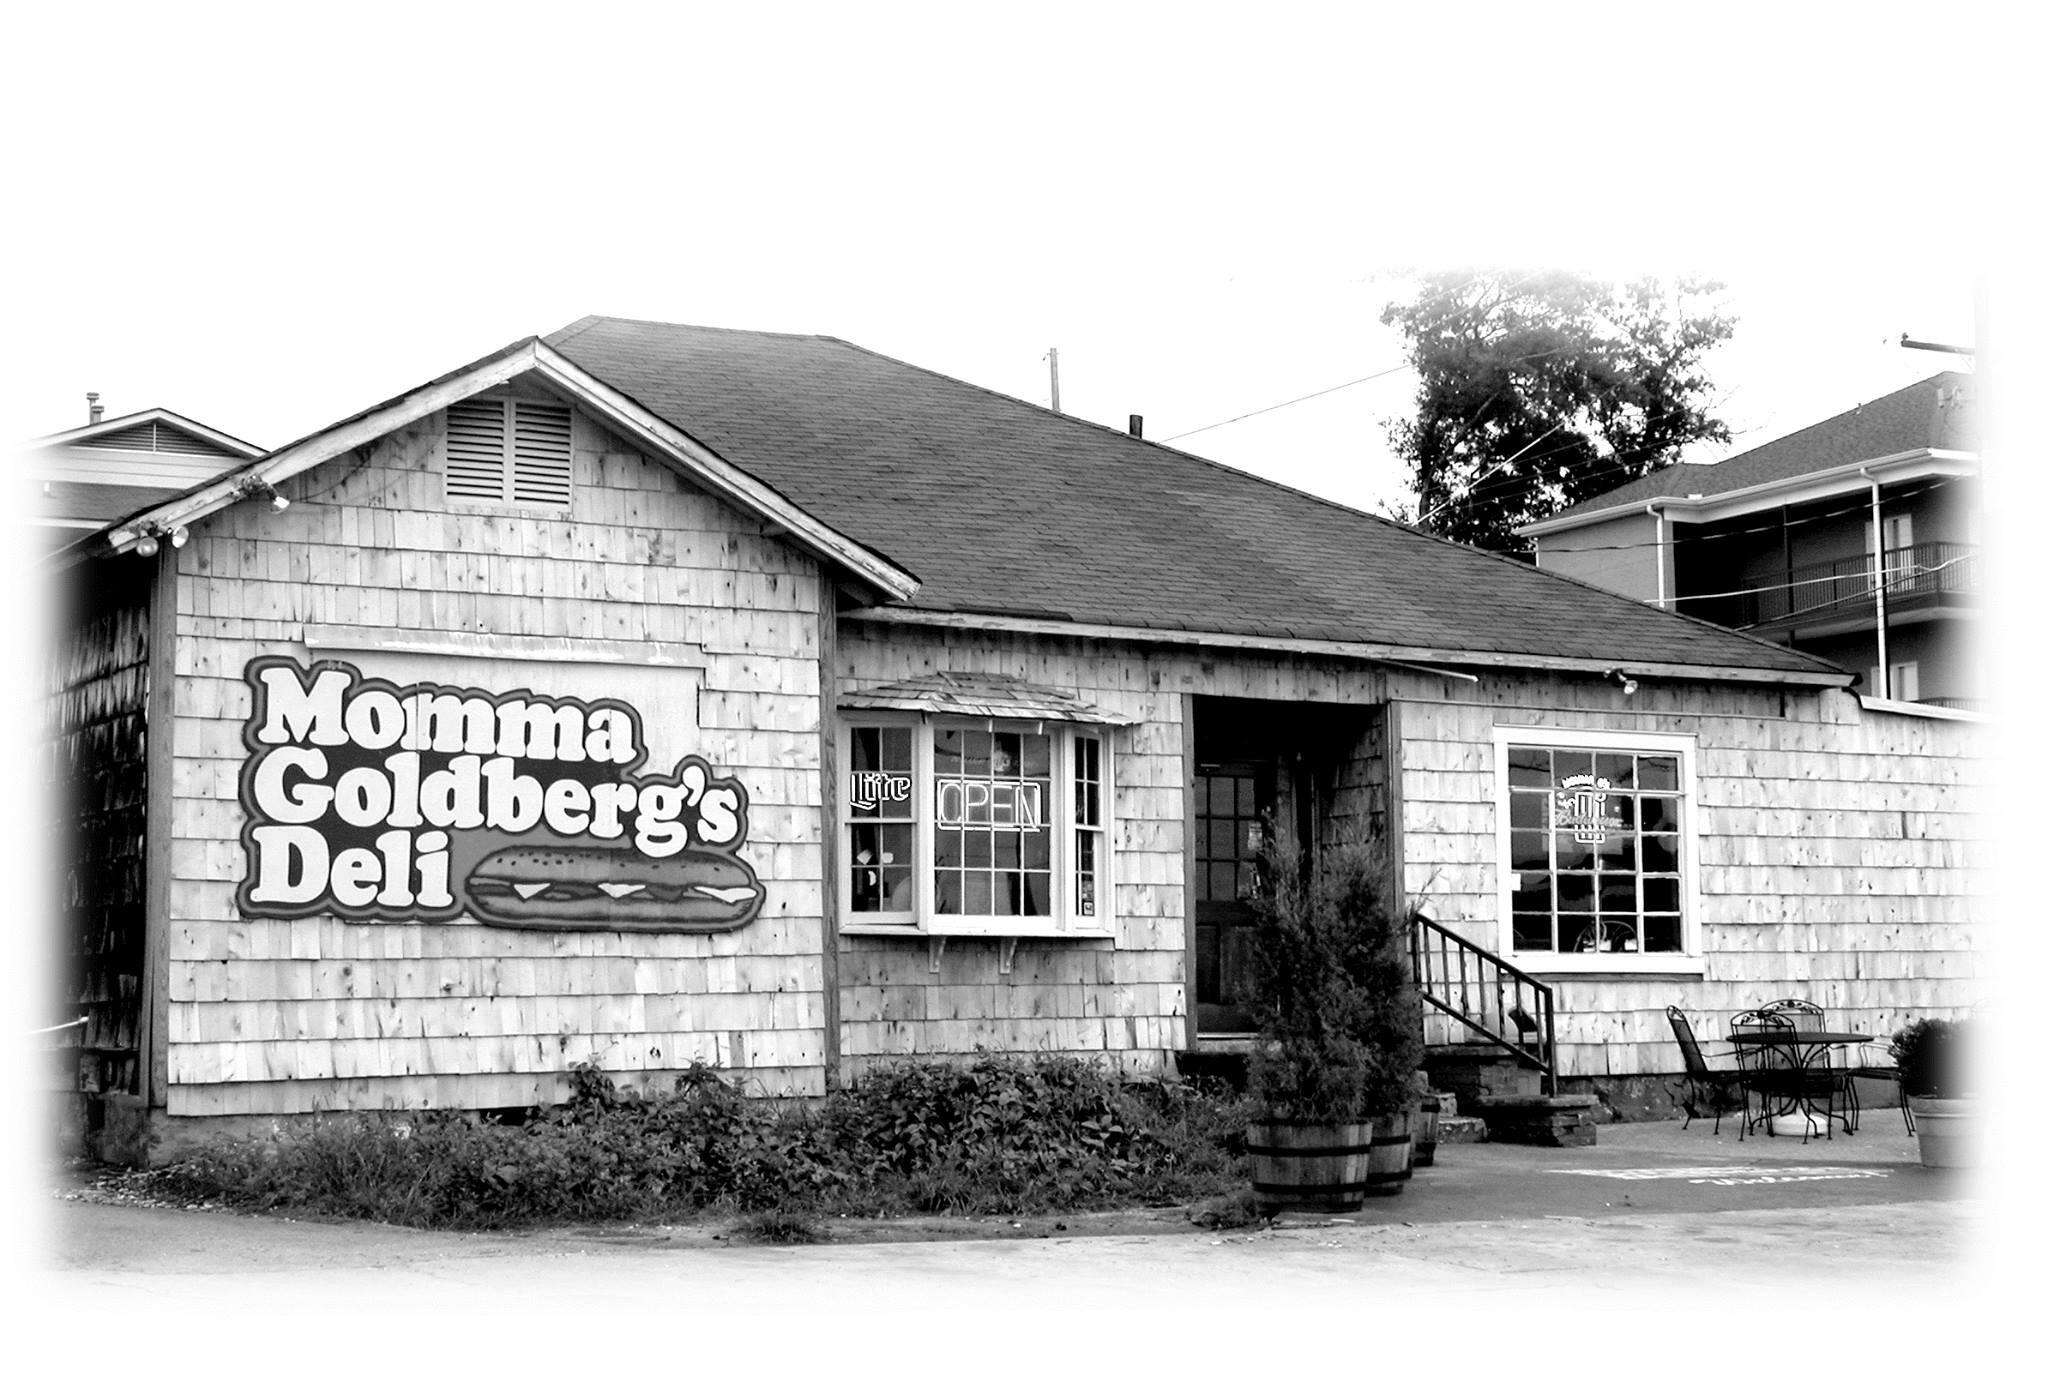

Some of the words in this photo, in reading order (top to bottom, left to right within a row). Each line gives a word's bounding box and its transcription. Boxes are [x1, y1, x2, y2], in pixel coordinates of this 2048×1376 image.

[258, 667, 636, 763] Momma
[254, 746, 738, 858] Goldberg's
[850, 773, 911, 810] Lite
[941, 782, 1039, 829] OPEN
[251, 825, 453, 907] Deli
